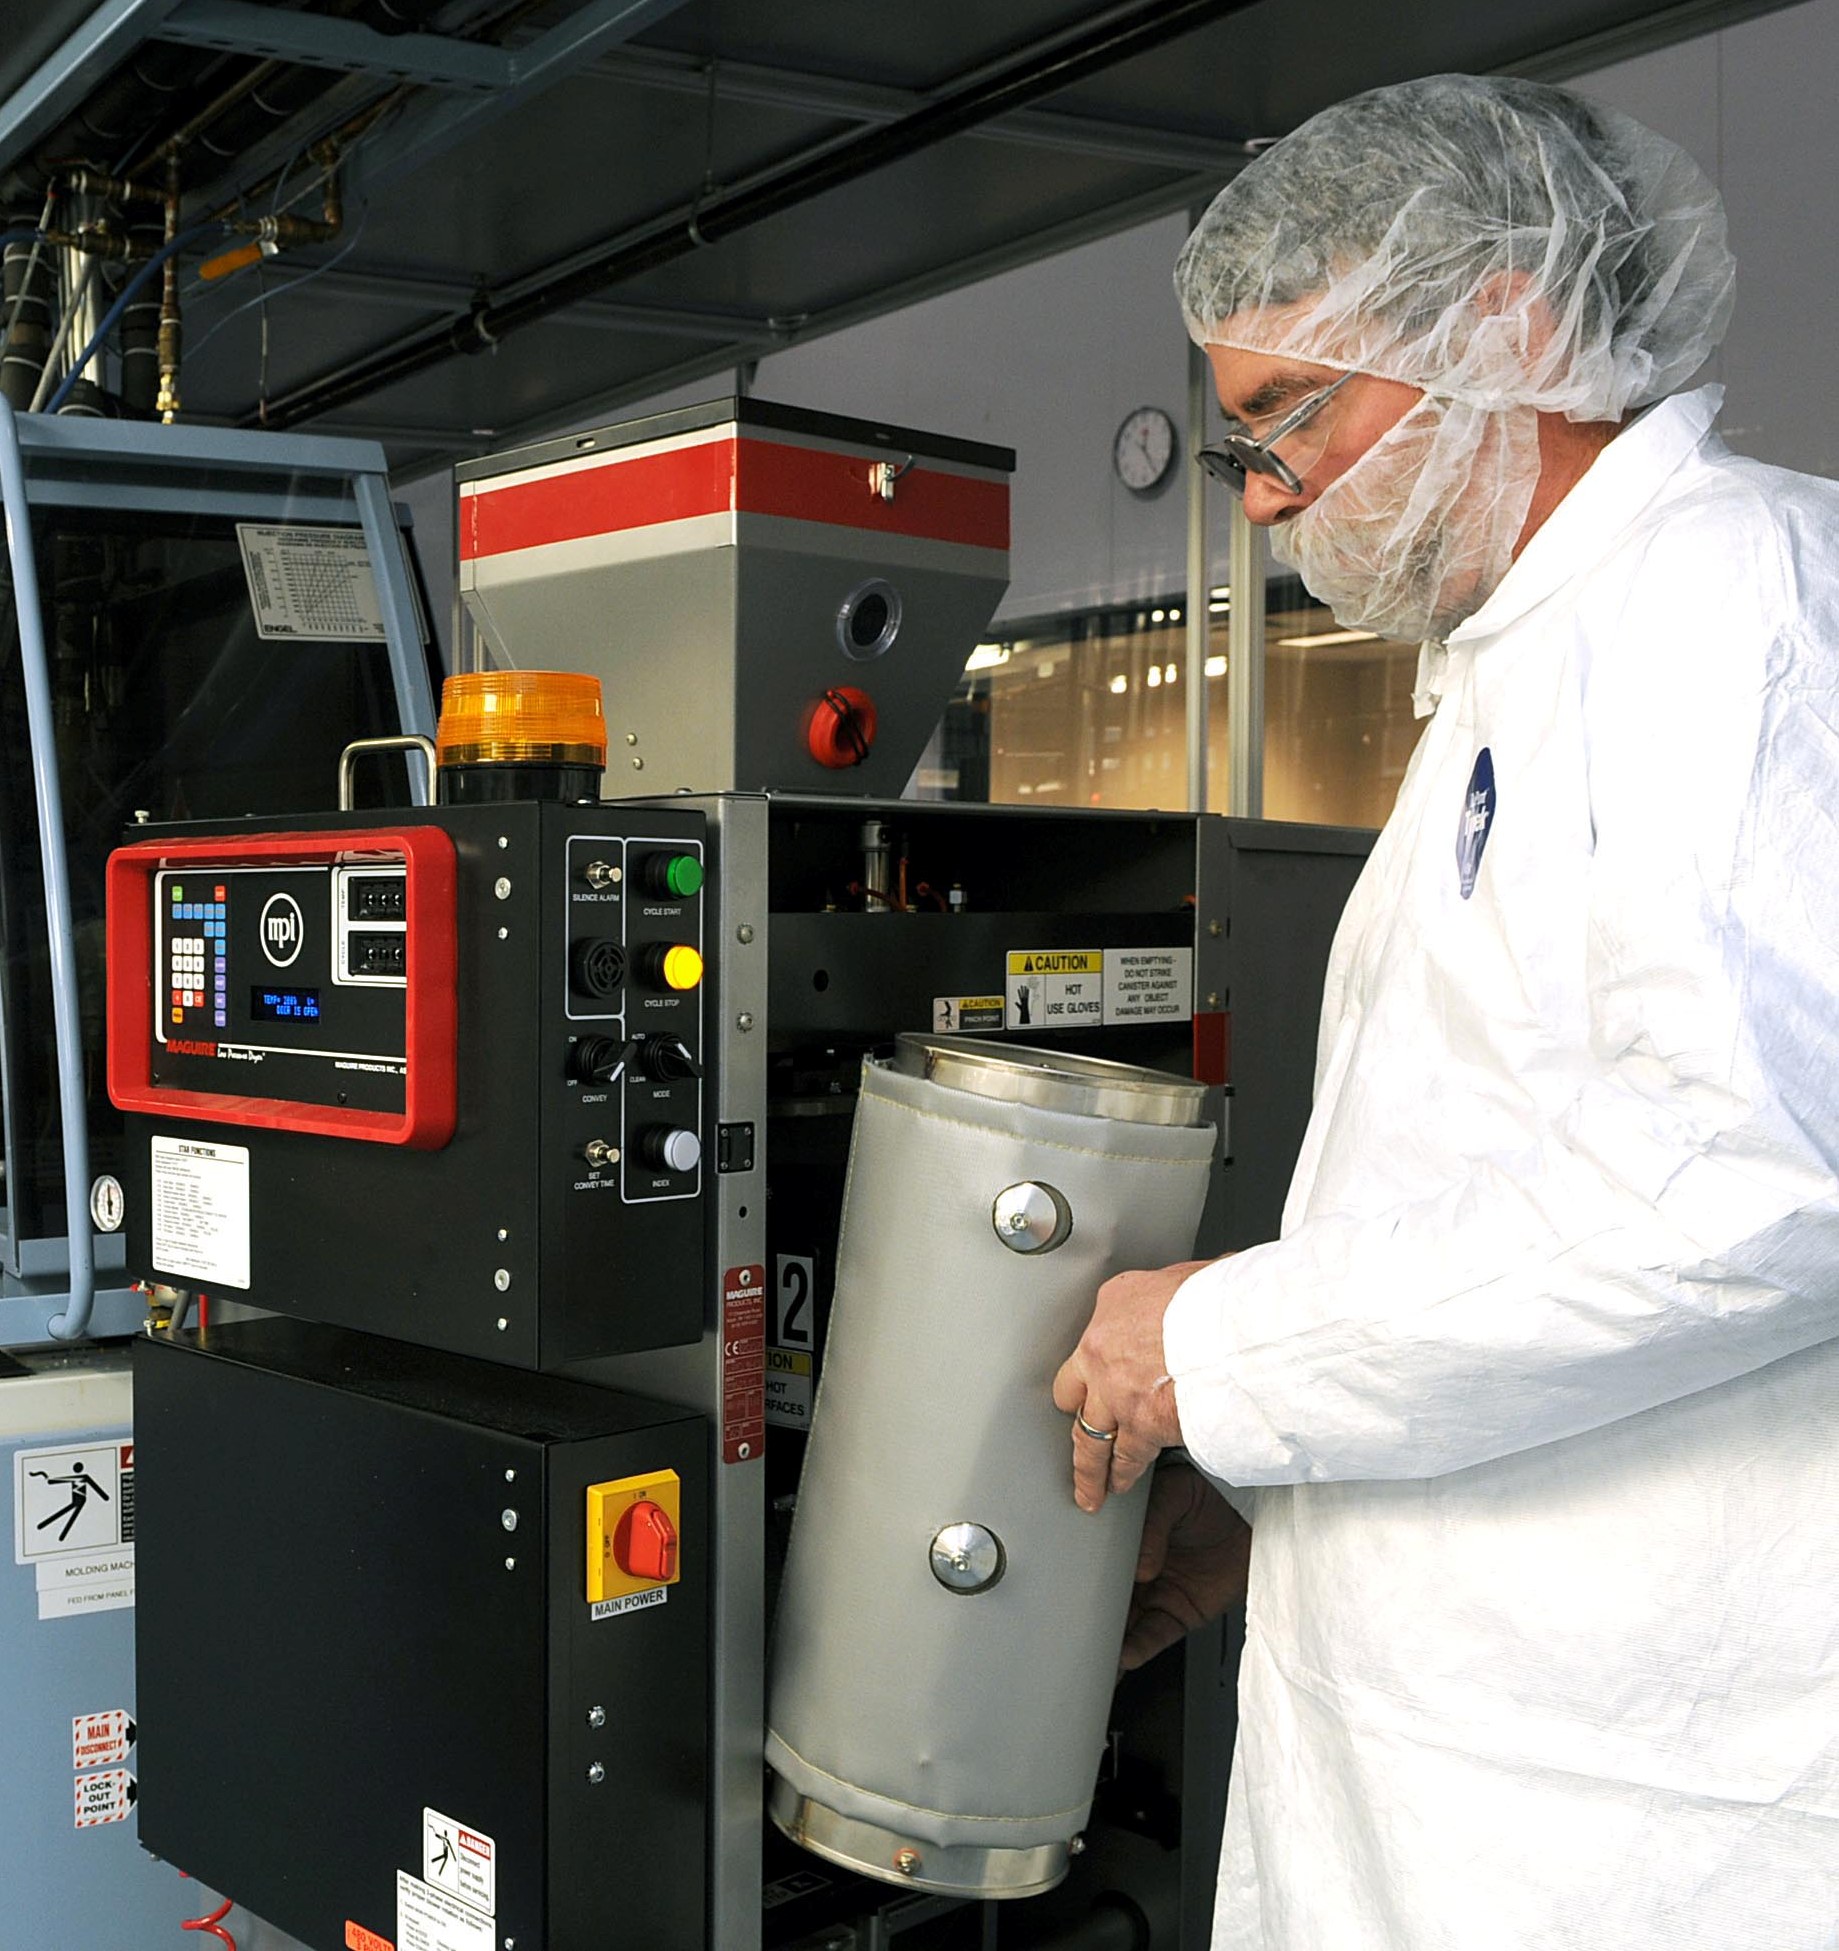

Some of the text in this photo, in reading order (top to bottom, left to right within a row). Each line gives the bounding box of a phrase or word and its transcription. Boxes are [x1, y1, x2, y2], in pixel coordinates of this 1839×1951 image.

[572, 894, 620, 902] SILENCE ALARM
[643, 908, 682, 916] CYCLE START
[268, 912, 296, 949] mpi
[1035, 955, 1088, 971] CAUTION
[1120, 957, 1139, 966] WHEN
[1124, 968, 1172, 978] DO NOT STRIKE
[1065, 984, 1083, 996] HOT
[1118, 980, 1178, 990] CANISTER AGAINST
[969, 998, 1000, 1008] CAUTION
[1128, 992, 1169, 1002] ANY OBJECT
[644, 999, 680, 1008] CYCLE STOP
[1046, 1001, 1100, 1015] USE GLOVES
[1115, 1004, 1180, 1016] DAMAGE MAY OCCUR
[983, 1014, 1000, 1022] POINT
[166, 1038, 217, 1057] MAGUIRE
[335, 1062, 358, 1070] MAGUIRE
[358, 1063, 386, 1073] PRODUCTS
[630, 1076, 646, 1084] CLEAN
[582, 1095, 608, 1103] CONVEY
[653, 1090, 671, 1098] MODE
[589, 1172, 601, 1180] SET
[574, 1180, 615, 1190] CONVEY TIME
[652, 1180, 670, 1188] INDEX
[726, 1286, 763, 1300] MAGUIRE
[782, 1262, 808, 1343] 2
[725, 1340, 739, 1356] CE
[768, 1352, 793, 1370] ION
[766, 1380, 788, 1394] HOT
[764, 1398, 804, 1416] RFACES
[66, 1564, 108, 1577] MOLDING
[67, 1596, 82, 1604] FED
[84, 1594, 104, 1602] FROM
[106, 1590, 128, 1599] PANEL
[595, 1589, 664, 1617] MAIN POWER
[88, 1723, 110, 1740] MAIN
[80, 1740, 117, 1756] DISCONNECT
[88, 1792, 111, 1803] OUT
[83, 1802, 116, 1814] POINT
